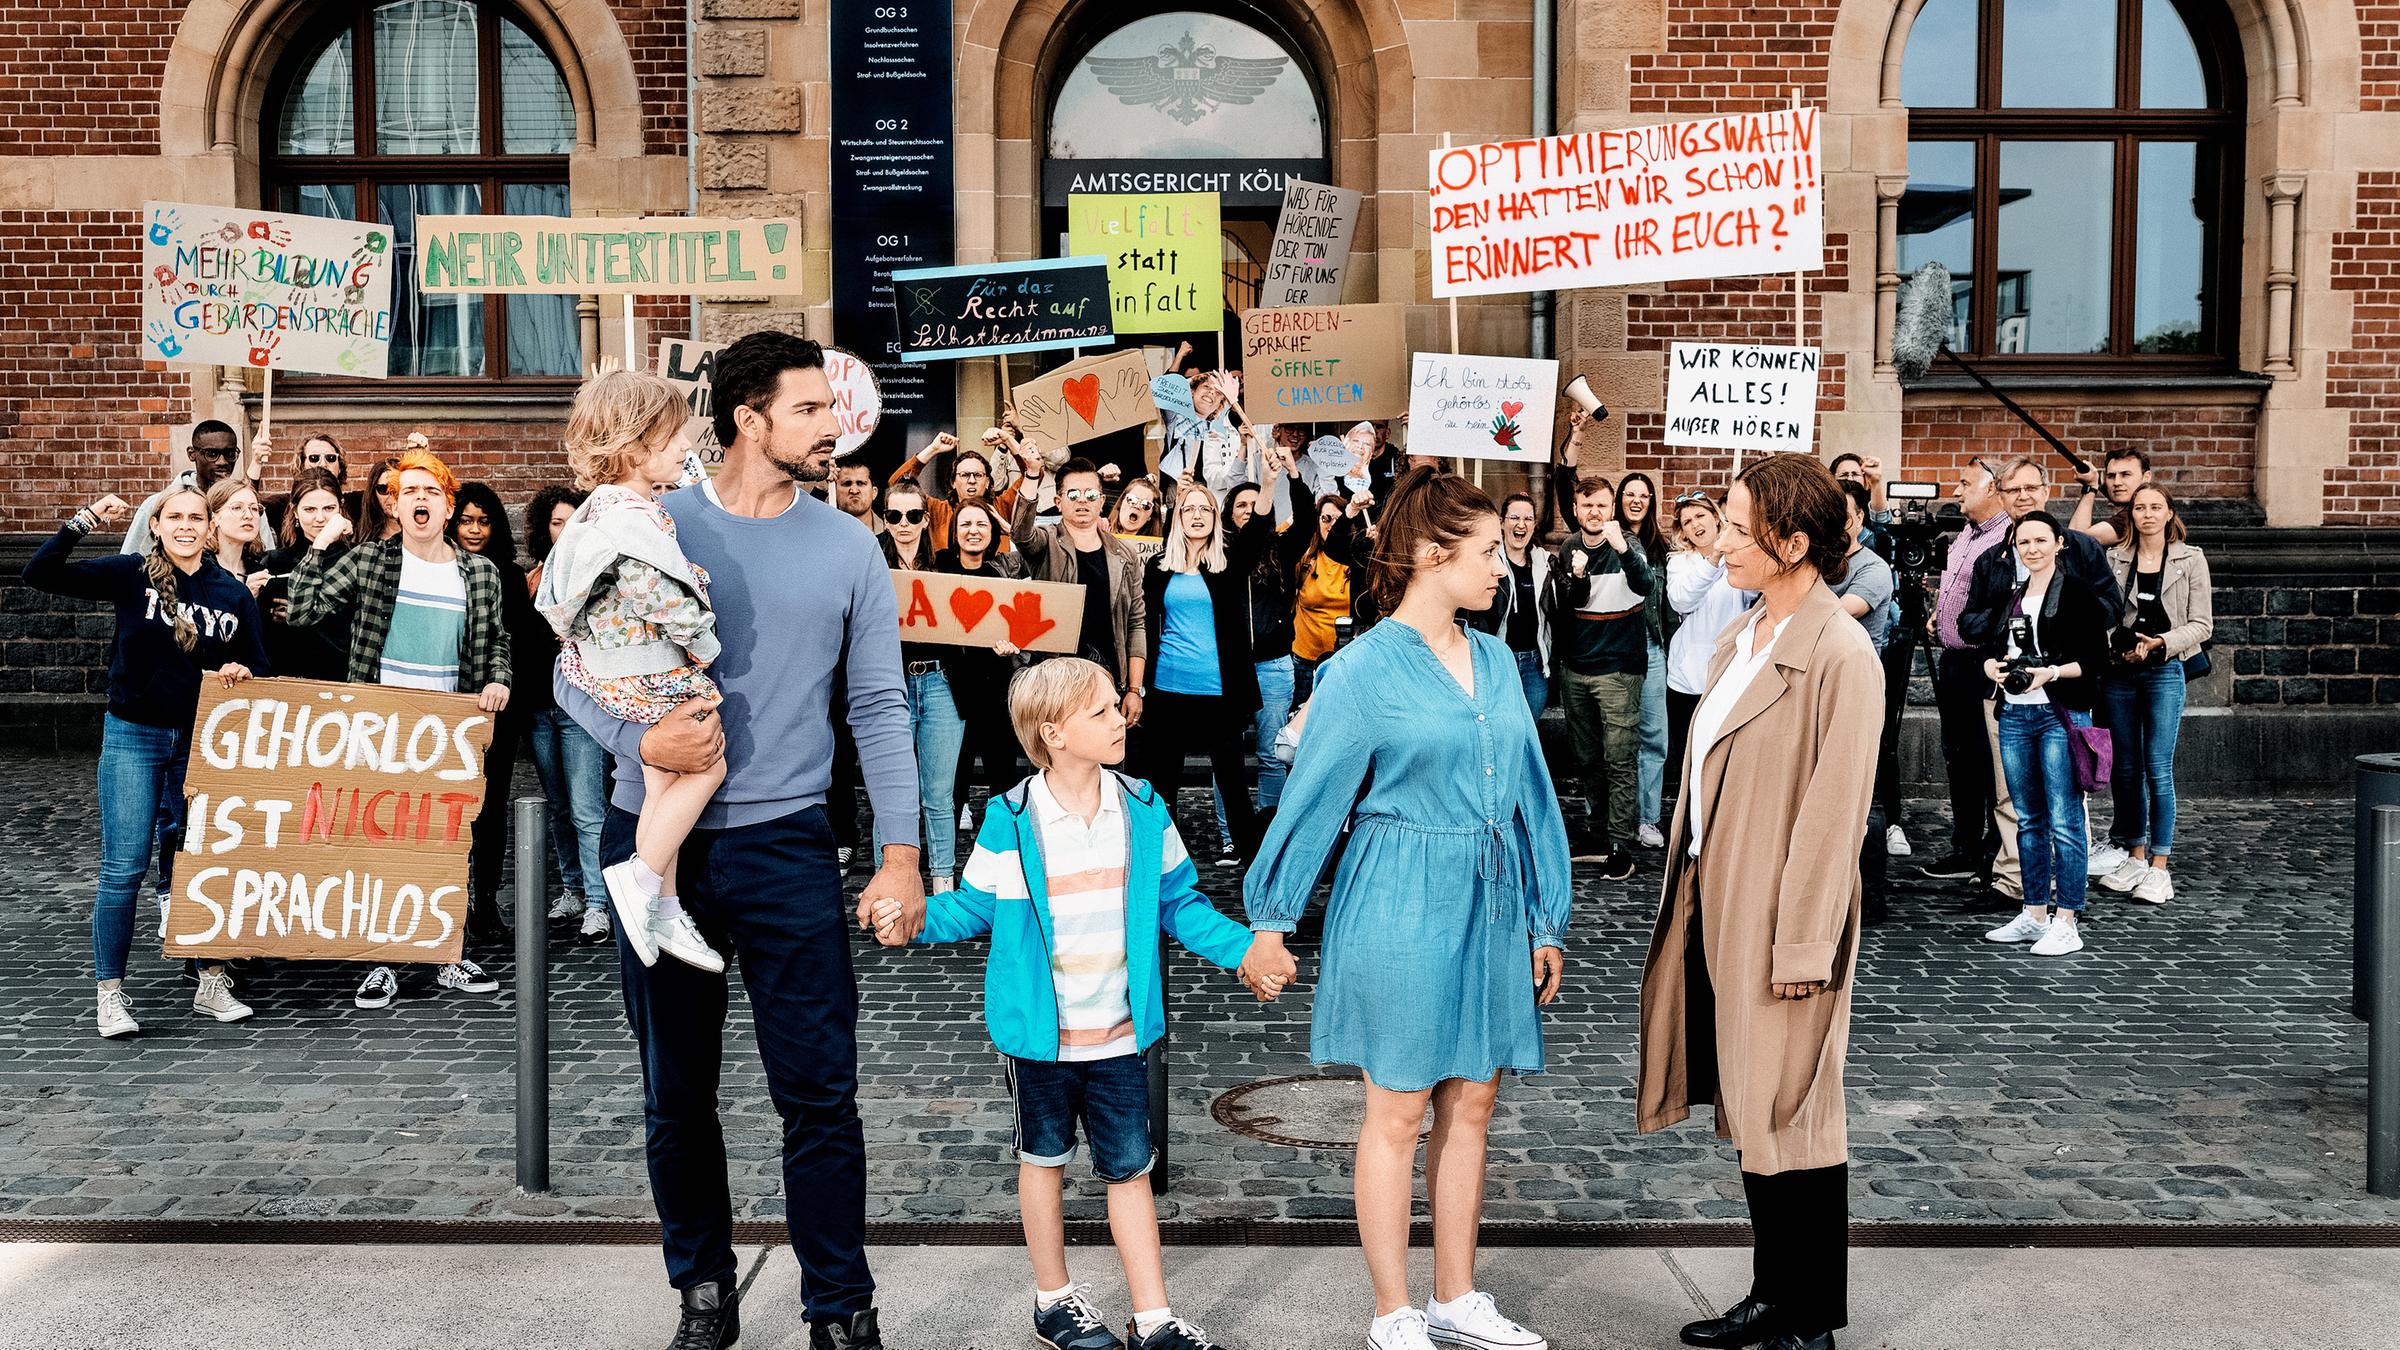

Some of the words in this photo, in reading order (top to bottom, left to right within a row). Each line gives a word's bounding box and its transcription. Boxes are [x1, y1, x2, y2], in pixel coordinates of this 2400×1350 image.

[875, 7, 896, 18] OG
[900, 7, 908, 18] 3
[864, 26, 918, 34] Grundbuchsachen
[875, 119, 897, 130] OG
[900, 119, 908, 130] 2
[840, 138, 874, 146] Wirtschafts-
[876, 138, 887, 146] und
[888, 138, 944, 146] Steuerrechtssachen
[850, 154, 934, 162] Zwangsversteigerungssachen
[885, 168, 930, 177] Bußgeldsachen
[1069, 173, 1231, 192] AMTSGERICHT
[862, 184, 922, 192] Zwangsvollstreckung
[1286, 185, 1310, 211] WAS
[1314, 189, 1338, 213] FÜR
[1432, 199, 1489, 233] DEN
[1498, 178, 1611, 221] HATTEN
[1282, 211, 1343, 238] HÖRENDE
[877, 235, 899, 246] OG
[903, 235, 908, 246] 1
[1275, 239, 1300, 260] DER
[1303, 242, 1328, 260] TON
[1615, 218, 1661, 261] IHR
[175, 246, 249, 281] MEHR
[248, 246, 374, 288] BILDUNG
[425, 231, 527, 287] MEHR
[864, 254, 923, 264] Aufgebotsverfahren
[1117, 248, 1178, 275] statt
[1268, 262, 1292, 280] IST
[1291, 262, 1314, 284] FÜR
[1314, 267, 1340, 284] UNS
[184, 282, 238, 298] DURCH
[966, 278, 1009, 298] Für
[1107, 281, 1198, 317] infalt
[1284, 288, 1309, 304] DER
[956, 296, 1039, 320] Recht
[1049, 298, 1091, 320] auf
[174, 299, 390, 342] GEBÄRDENSPRACHE
[908, 322, 1109, 348] Selbstbestimmung
[1246, 335, 1312, 358] SPRACHE
[667, 343, 727, 382] LA
[1271, 358, 1342, 378] ÖFFNET
[1732, 346, 1816, 373] KÖNNEN
[1413, 360, 1452, 388] Ich
[1461, 367, 1490, 388] bin
[1495, 373, 1533, 391] stolz
[1276, 383, 1364, 407] CHANCEN
[1689, 381, 1789, 405] ALLES!
[1432, 395, 1491, 421] gehörlos
[1464, 417, 1490, 430] sein
[1732, 415, 1800, 439] HÖREN
[199, 691, 490, 781] GEHÖRLOS
[182, 792, 293, 856] IST
[301, 781, 481, 847] NICHT
[174, 866, 462, 949] SPRACHLOS
